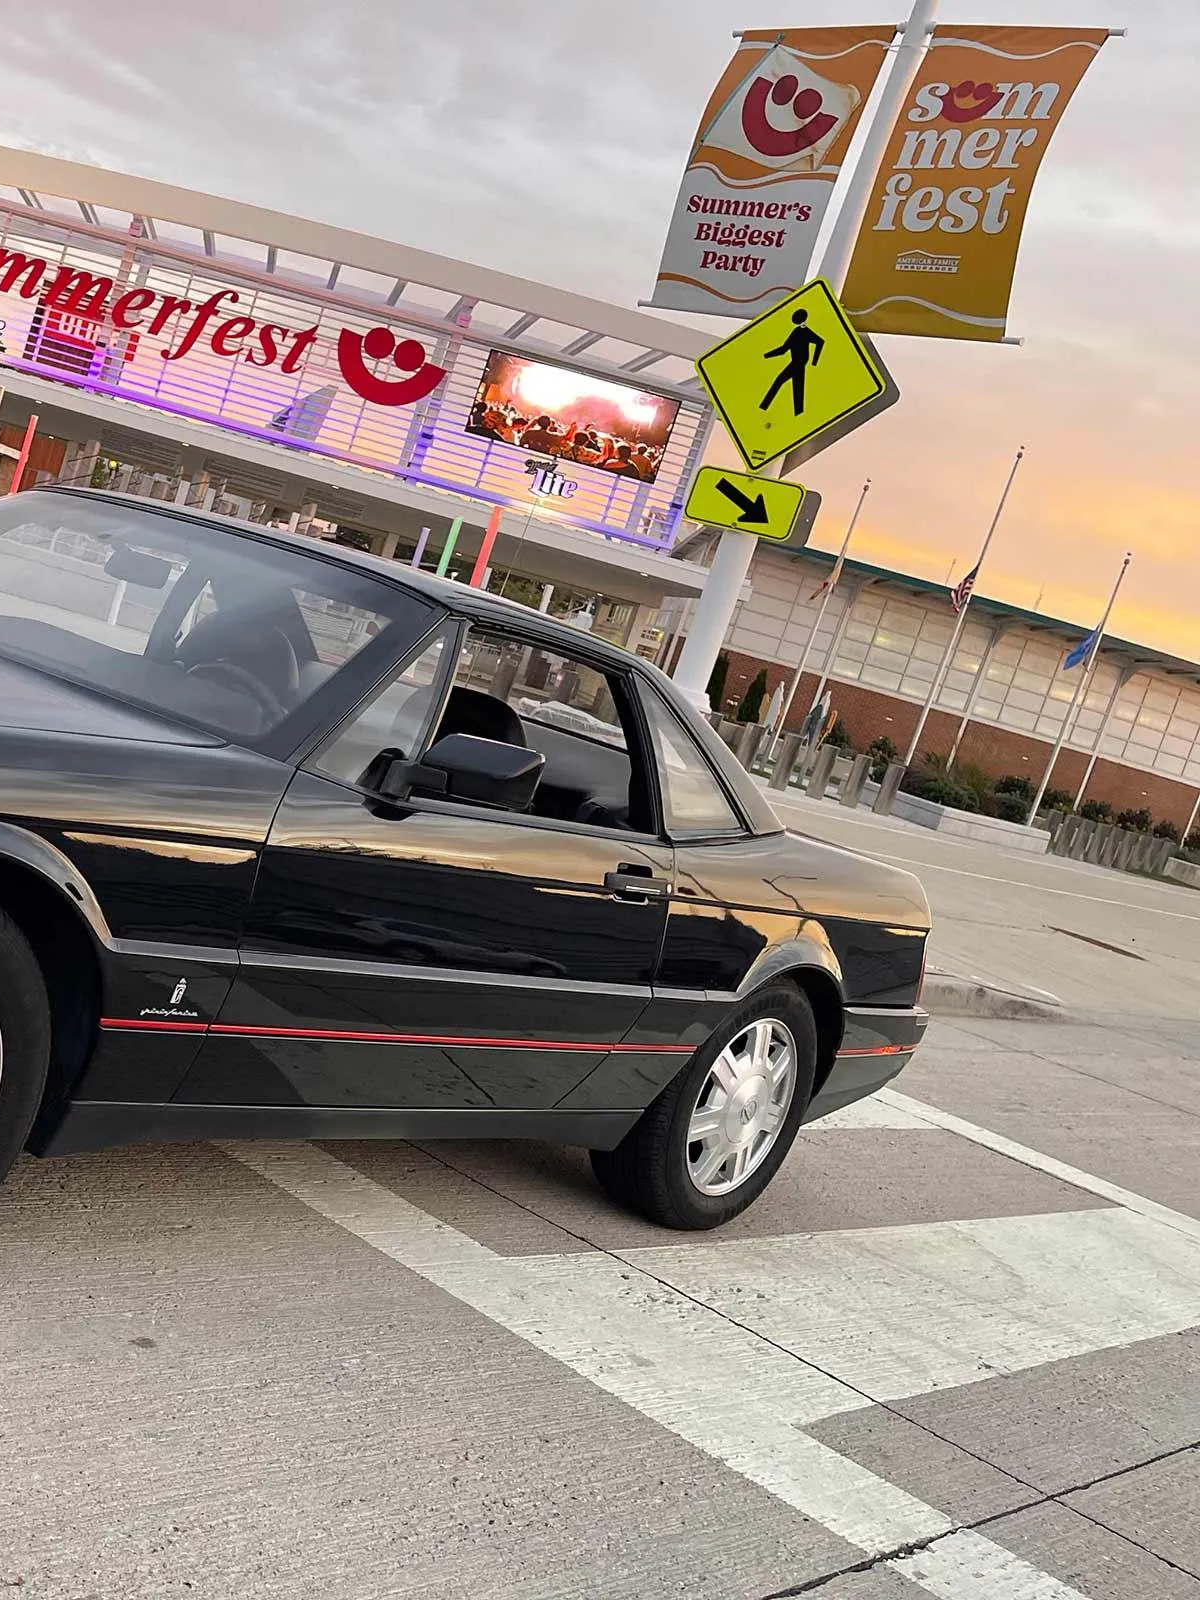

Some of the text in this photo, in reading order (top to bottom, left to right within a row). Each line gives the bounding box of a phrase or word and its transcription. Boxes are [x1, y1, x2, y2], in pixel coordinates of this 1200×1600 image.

[891, 127, 1039, 170] mer
[686, 194, 813, 222] Summer's
[871, 172, 1017, 235] fest
[694, 221, 788, 249] Biggest
[699, 250, 766, 278] Party
[528, 468, 578, 499] Lite
